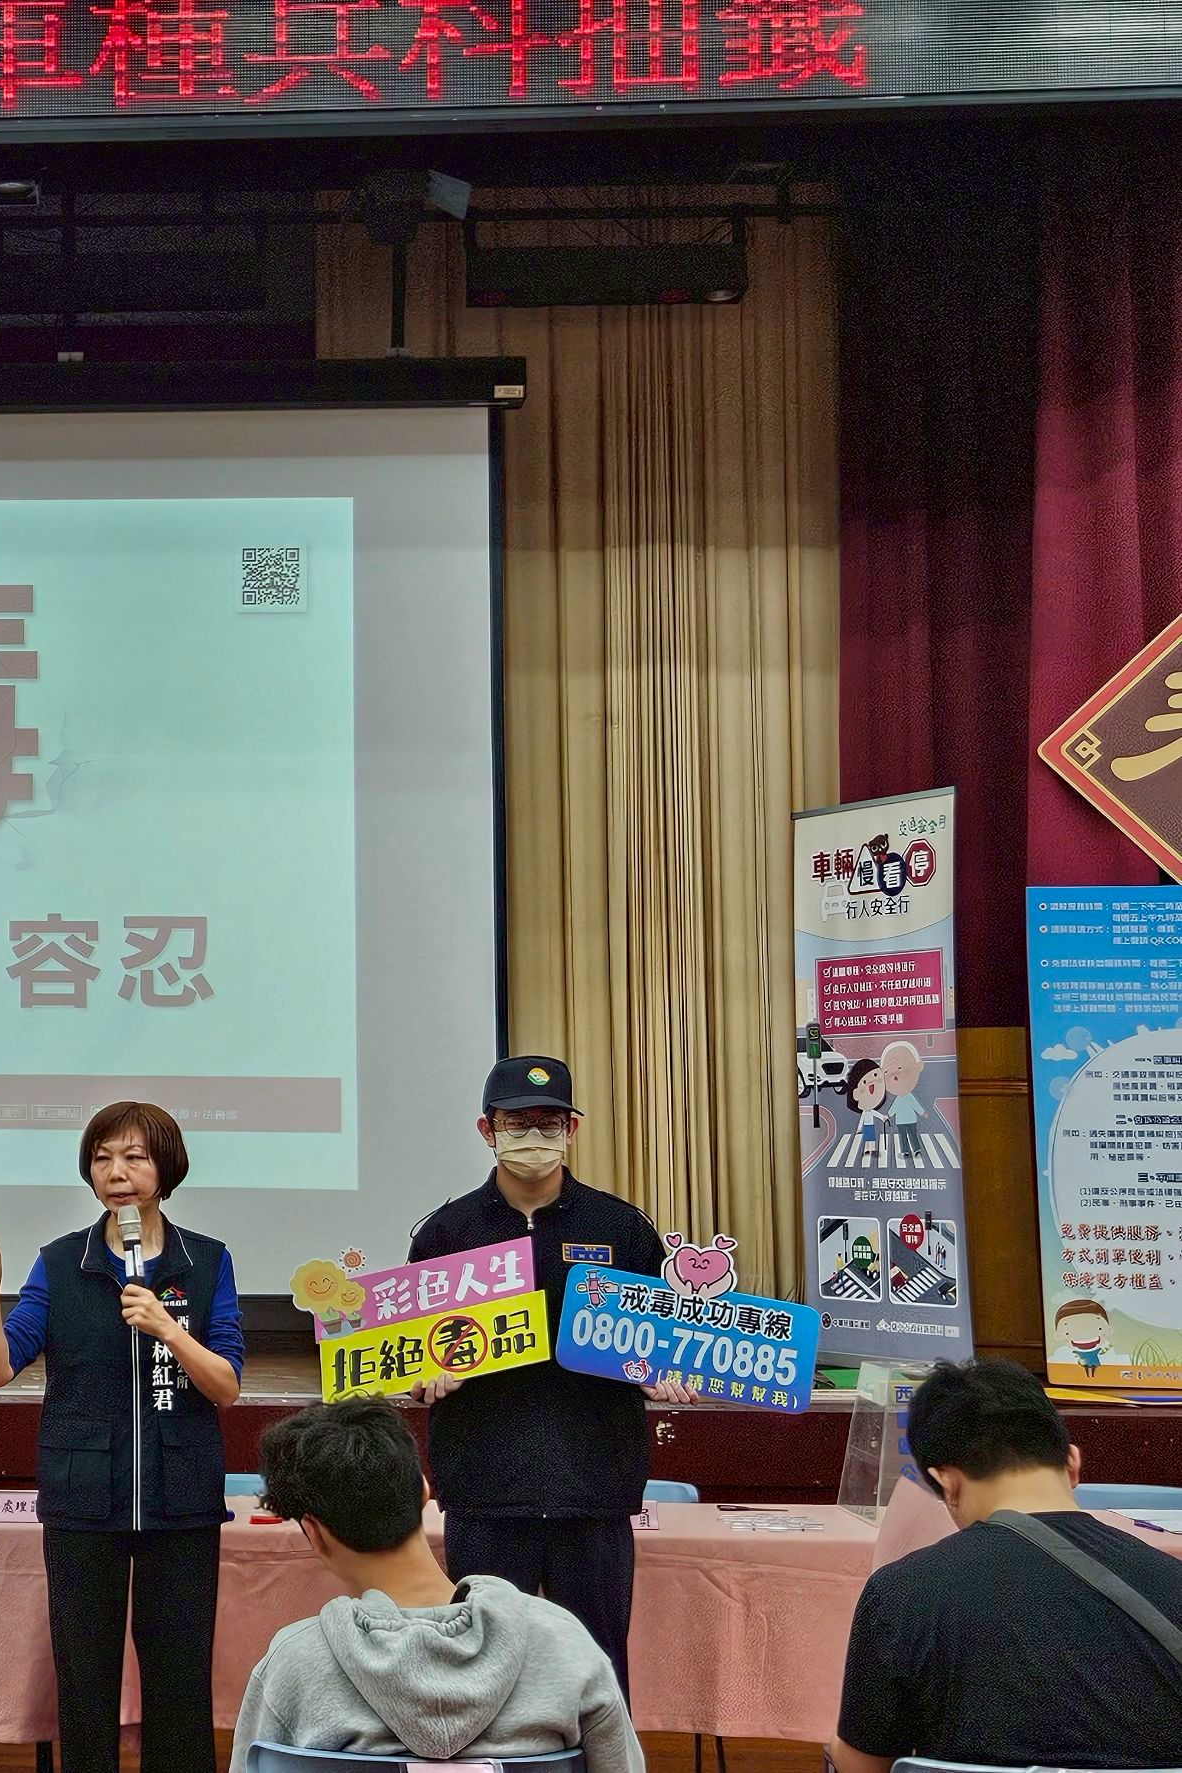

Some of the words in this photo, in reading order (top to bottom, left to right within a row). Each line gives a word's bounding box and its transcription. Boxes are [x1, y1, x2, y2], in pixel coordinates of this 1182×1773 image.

[845, 895, 911, 919] 行人安全行
[372, 1250, 526, 1322] 彩色人生
[619, 1285, 793, 1340] 戒毒成功專線
[151, 1340, 174, 1411] 林紅君
[331, 1310, 536, 1393] 拒絕毒品
[572, 1309, 798, 1386] 0800-770885
